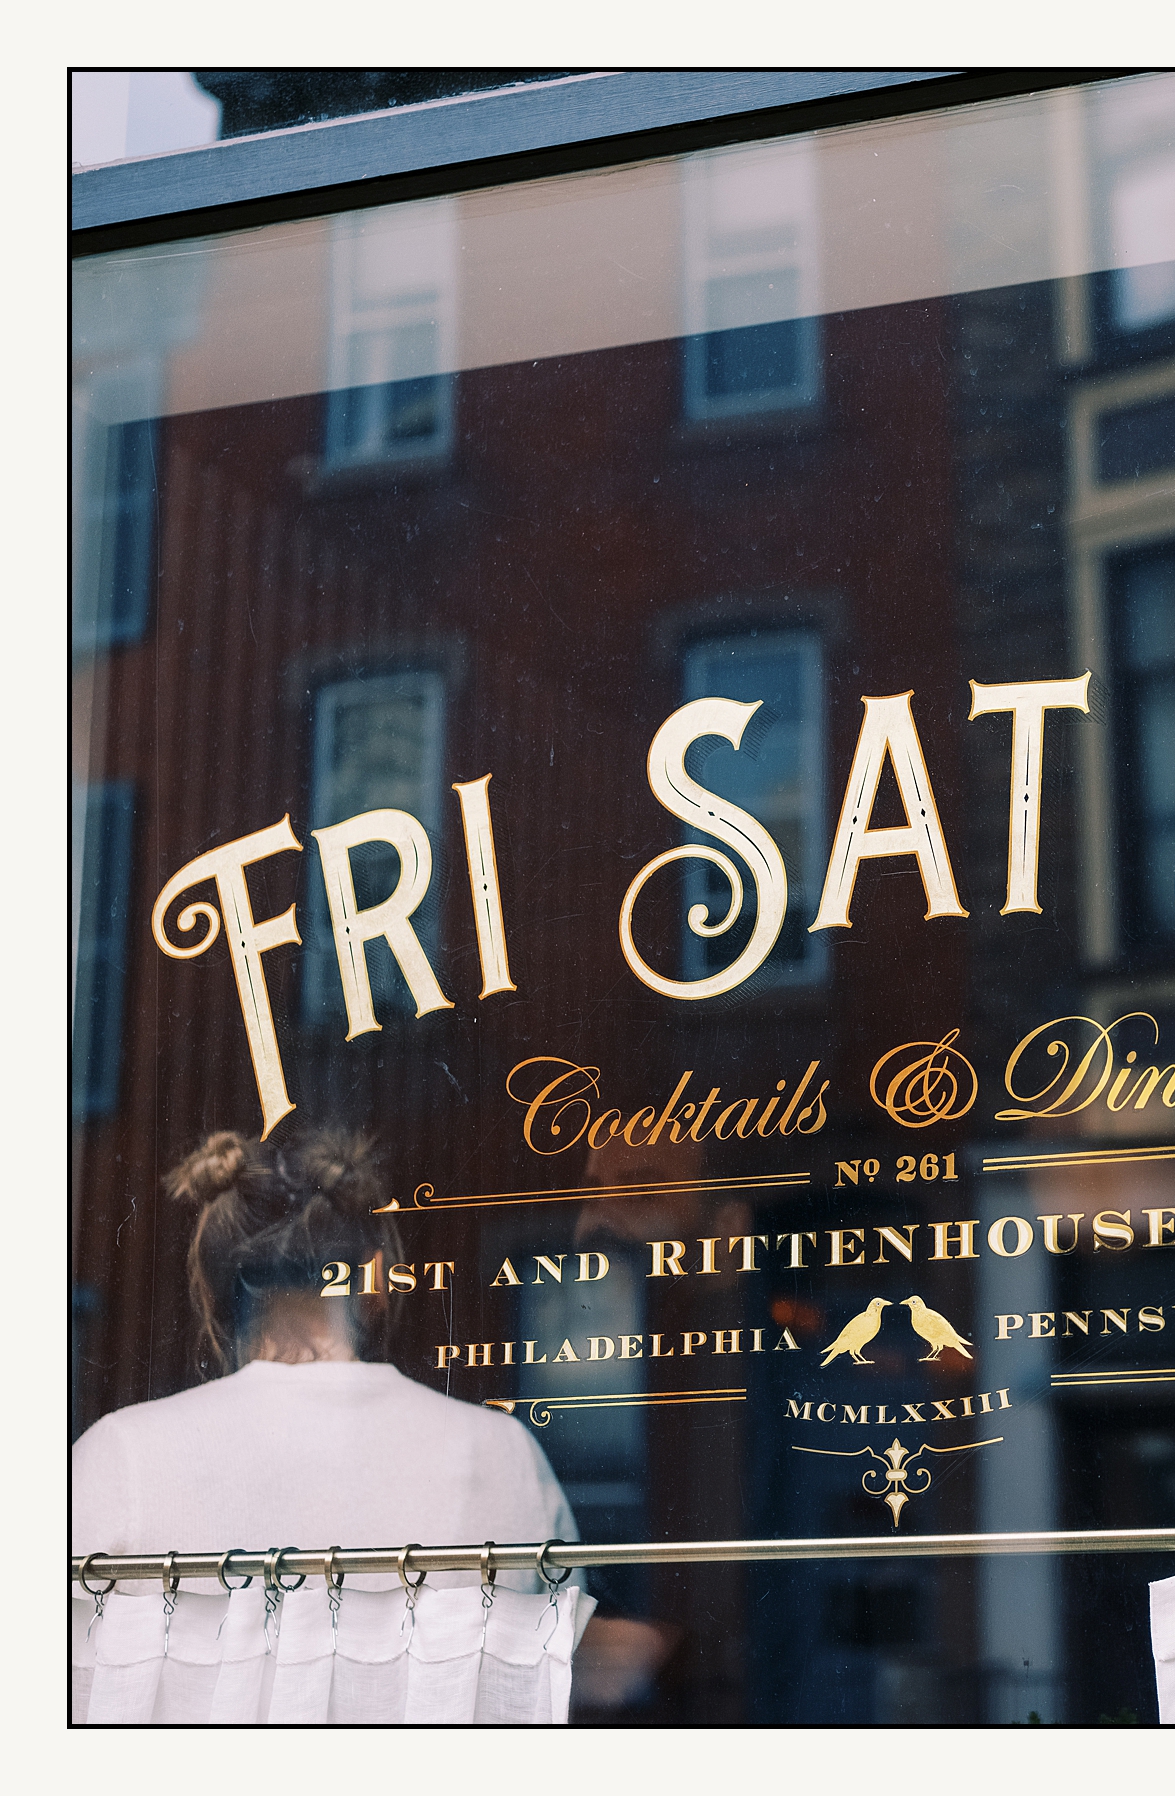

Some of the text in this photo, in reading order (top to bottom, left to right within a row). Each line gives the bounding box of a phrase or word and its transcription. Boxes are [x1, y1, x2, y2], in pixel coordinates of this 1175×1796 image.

[151, 773, 518, 1142] FRI
[619, 670, 1092, 999] SAT
[506, 1056, 831, 1155] Cocktails
[869, 1028, 979, 1129] &
[896, 1153, 959, 1183] 261
[320, 1259, 456, 1298] 21ST
[489, 1251, 611, 1287] AND
[434, 1327, 802, 1370] PHILADELPHIA
[783, 1388, 1014, 1425] MCMLXXIII
